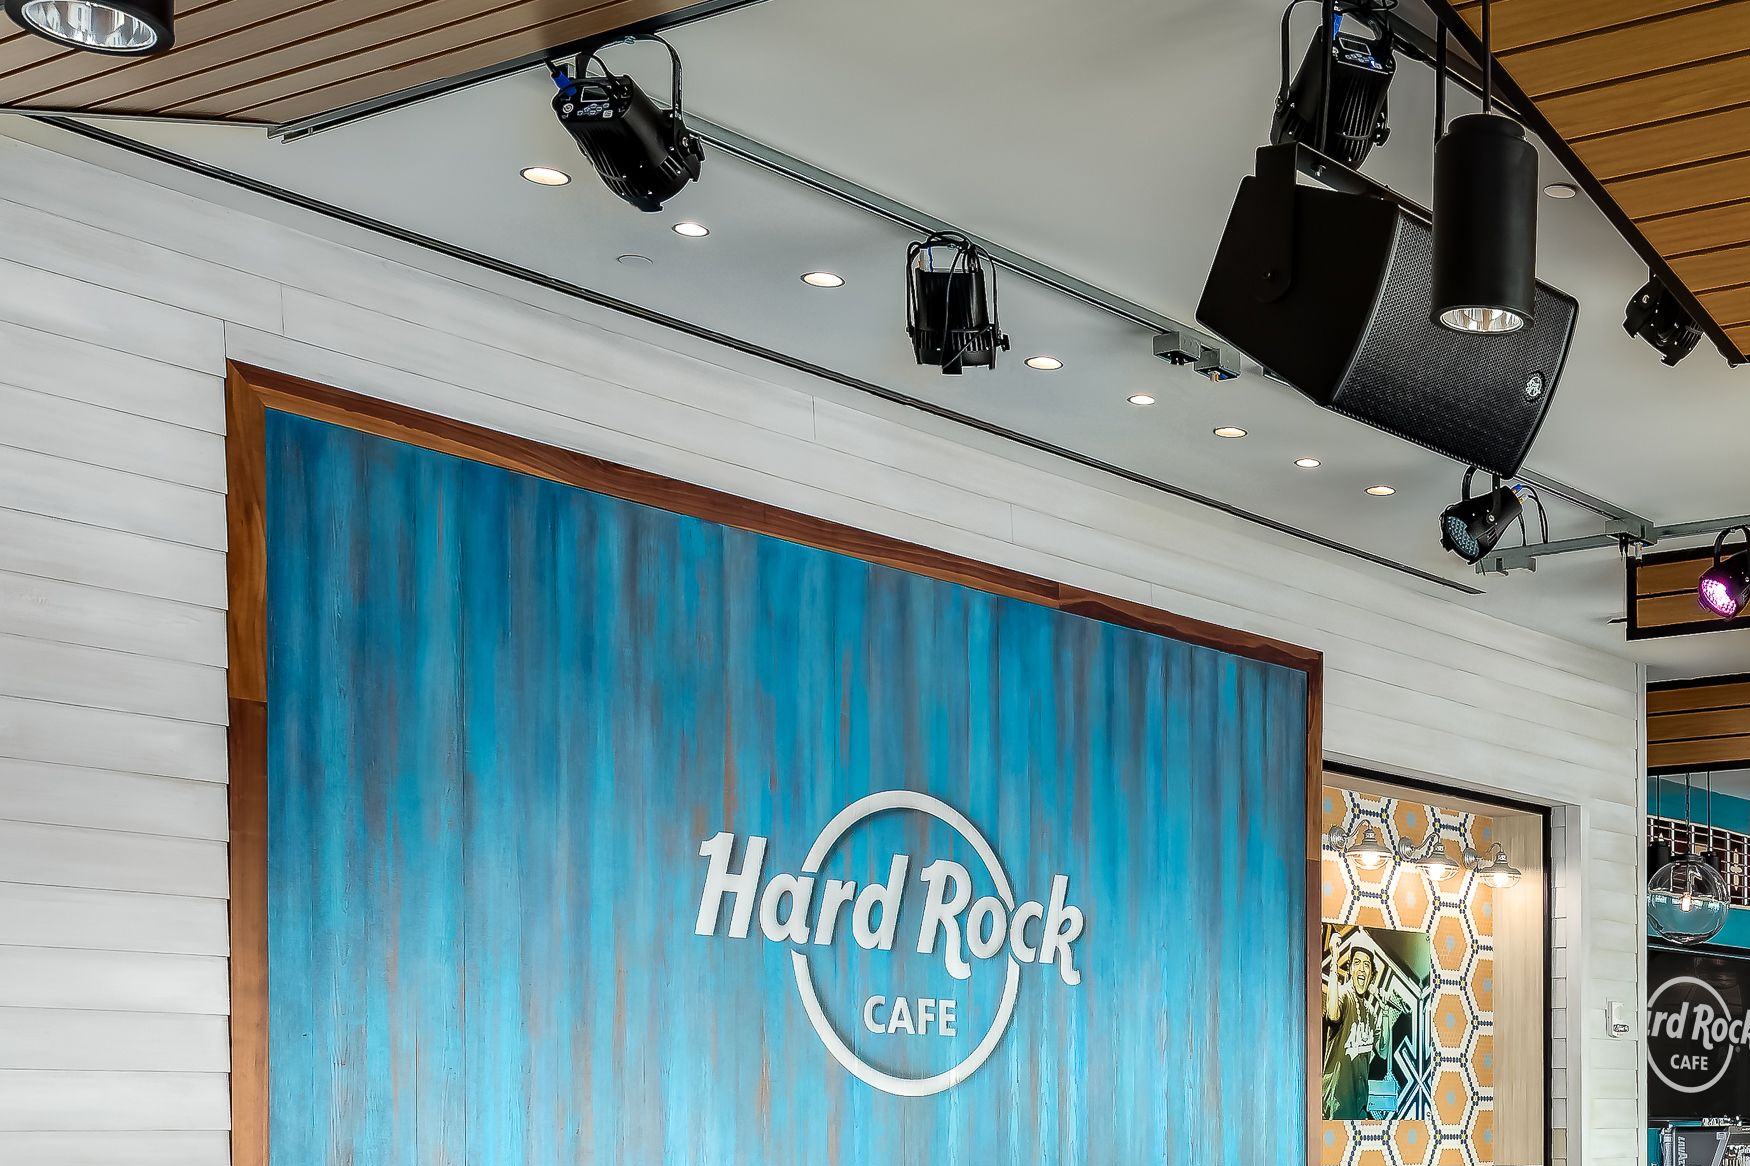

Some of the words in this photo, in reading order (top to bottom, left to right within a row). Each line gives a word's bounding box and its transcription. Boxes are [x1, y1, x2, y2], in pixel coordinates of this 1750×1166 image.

[695, 832, 910, 951] Hard
[916, 858, 1085, 986] Rock
[863, 995, 958, 1037] CAFE
[1647, 1001, 1690, 1039] rd
[1670, 1054, 1709, 1071] CAFE
